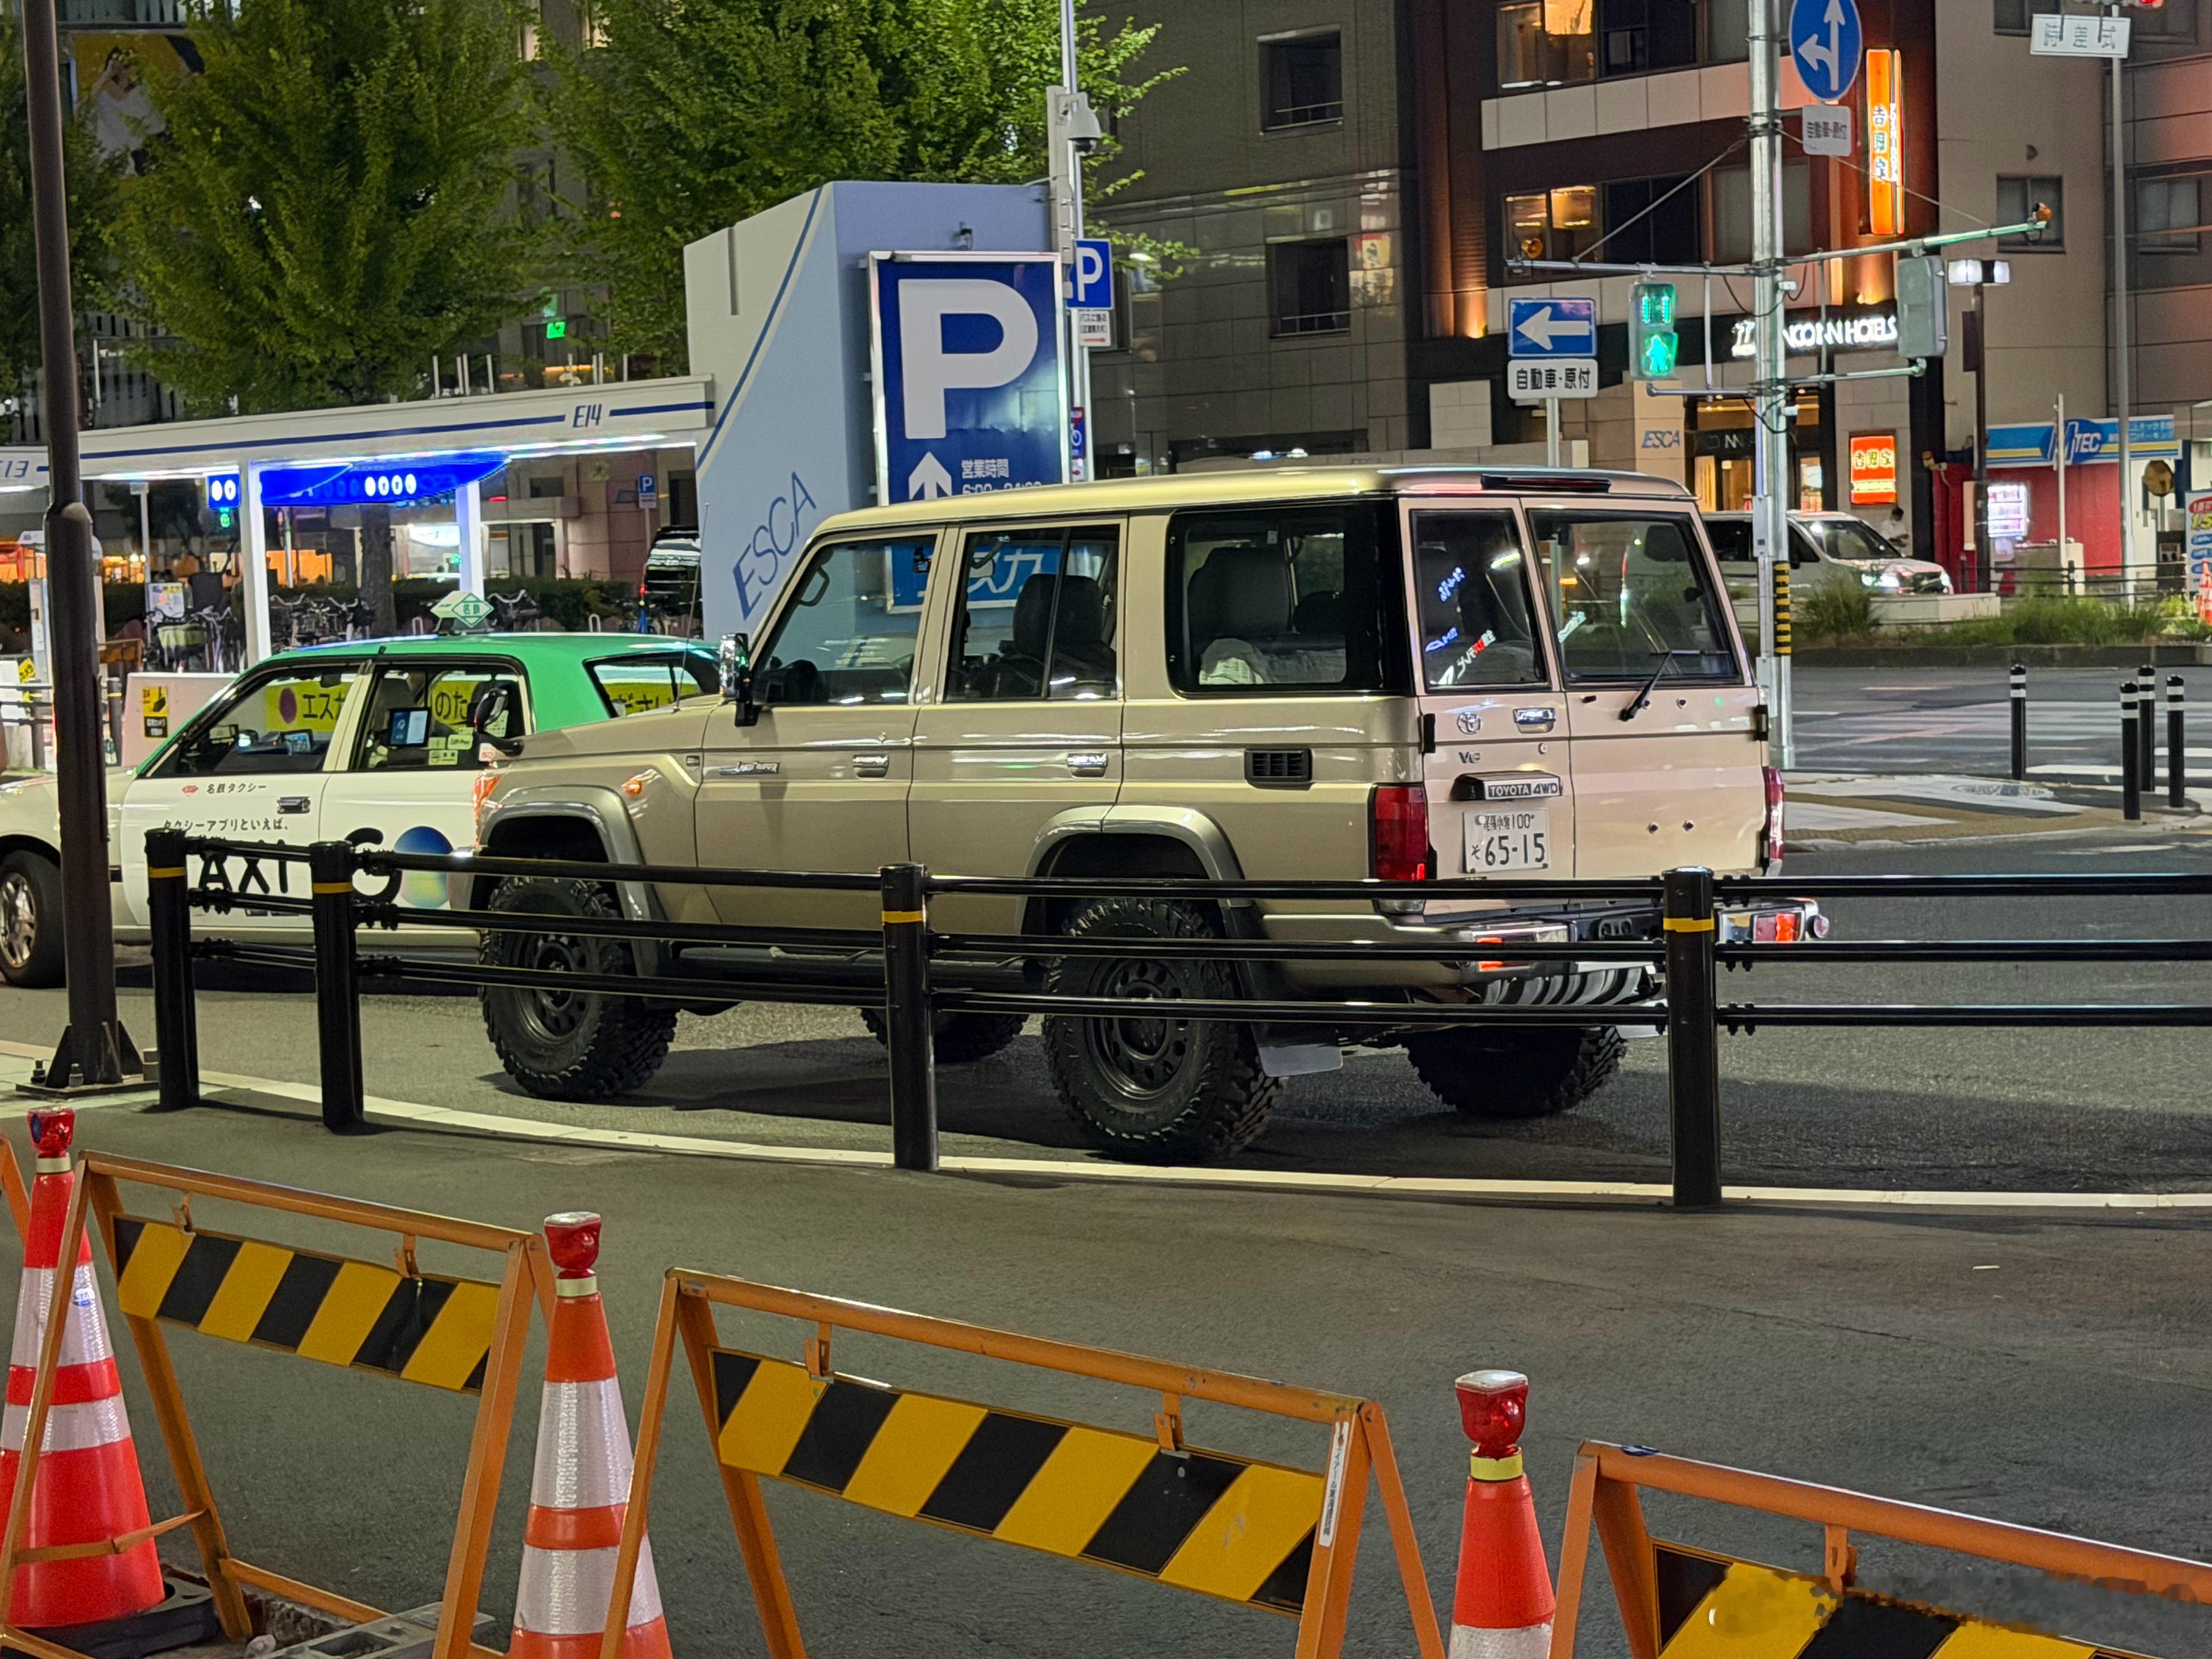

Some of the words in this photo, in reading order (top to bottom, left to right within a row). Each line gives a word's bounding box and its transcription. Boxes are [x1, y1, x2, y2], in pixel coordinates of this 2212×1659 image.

[1076, 247, 1103, 302] P
[1843, 315, 1899, 345] HOTELS
[898, 279, 1039, 439] P
[1516, 367, 1591, 390] 自動車・原付
[572, 403, 602, 428] E14
[1641, 430, 1681, 449] ESCA
[0, 460, 29, 478] 13
[961, 459, 1009, 479] 営業時間
[642, 476, 653, 492] P
[732, 471, 817, 621] ESCA
[917, 549, 1045, 597] スカ
[1489, 785, 1529, 797] TOYOTA
[1532, 783, 1558, 794] 4WD
[1511, 813, 1532, 830] 100
[1485, 832, 1545, 866] 65-15
